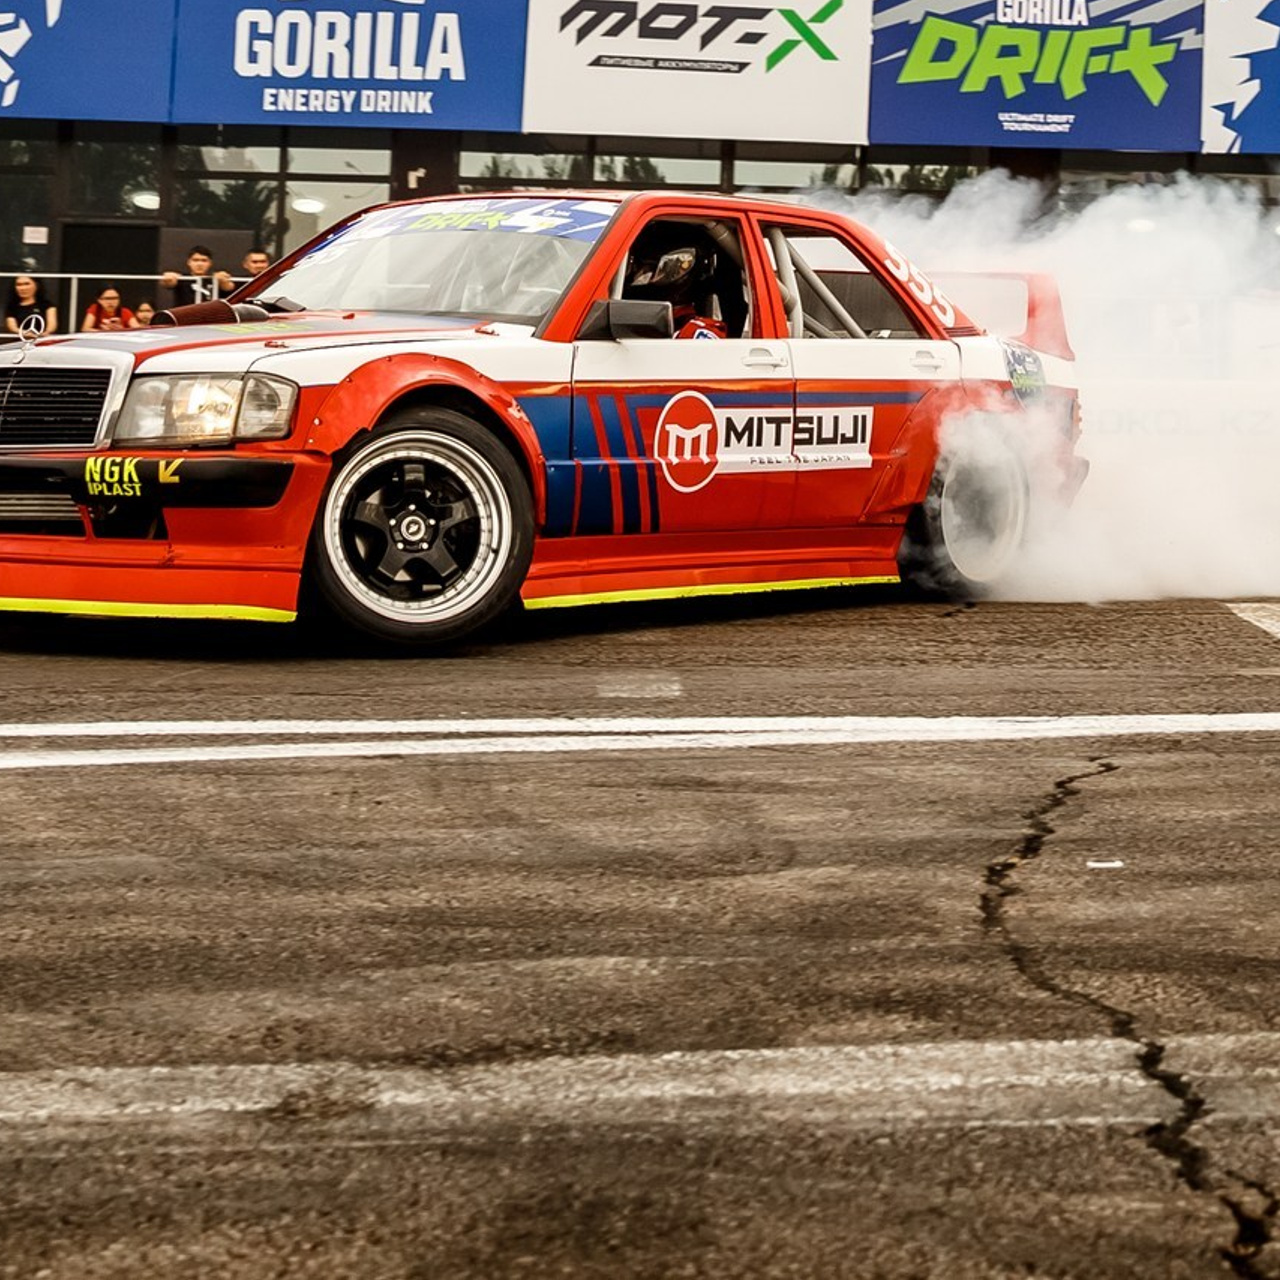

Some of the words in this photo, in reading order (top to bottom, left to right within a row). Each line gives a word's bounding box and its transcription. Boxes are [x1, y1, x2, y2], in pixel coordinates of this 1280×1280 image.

[233, 8, 467, 81] GORILLA
[262, 88, 356, 113] ENERGY
[360, 90, 433, 114] DRINK
[723, 415, 868, 448] MITSUJI
[84, 457, 142, 483] NGK
